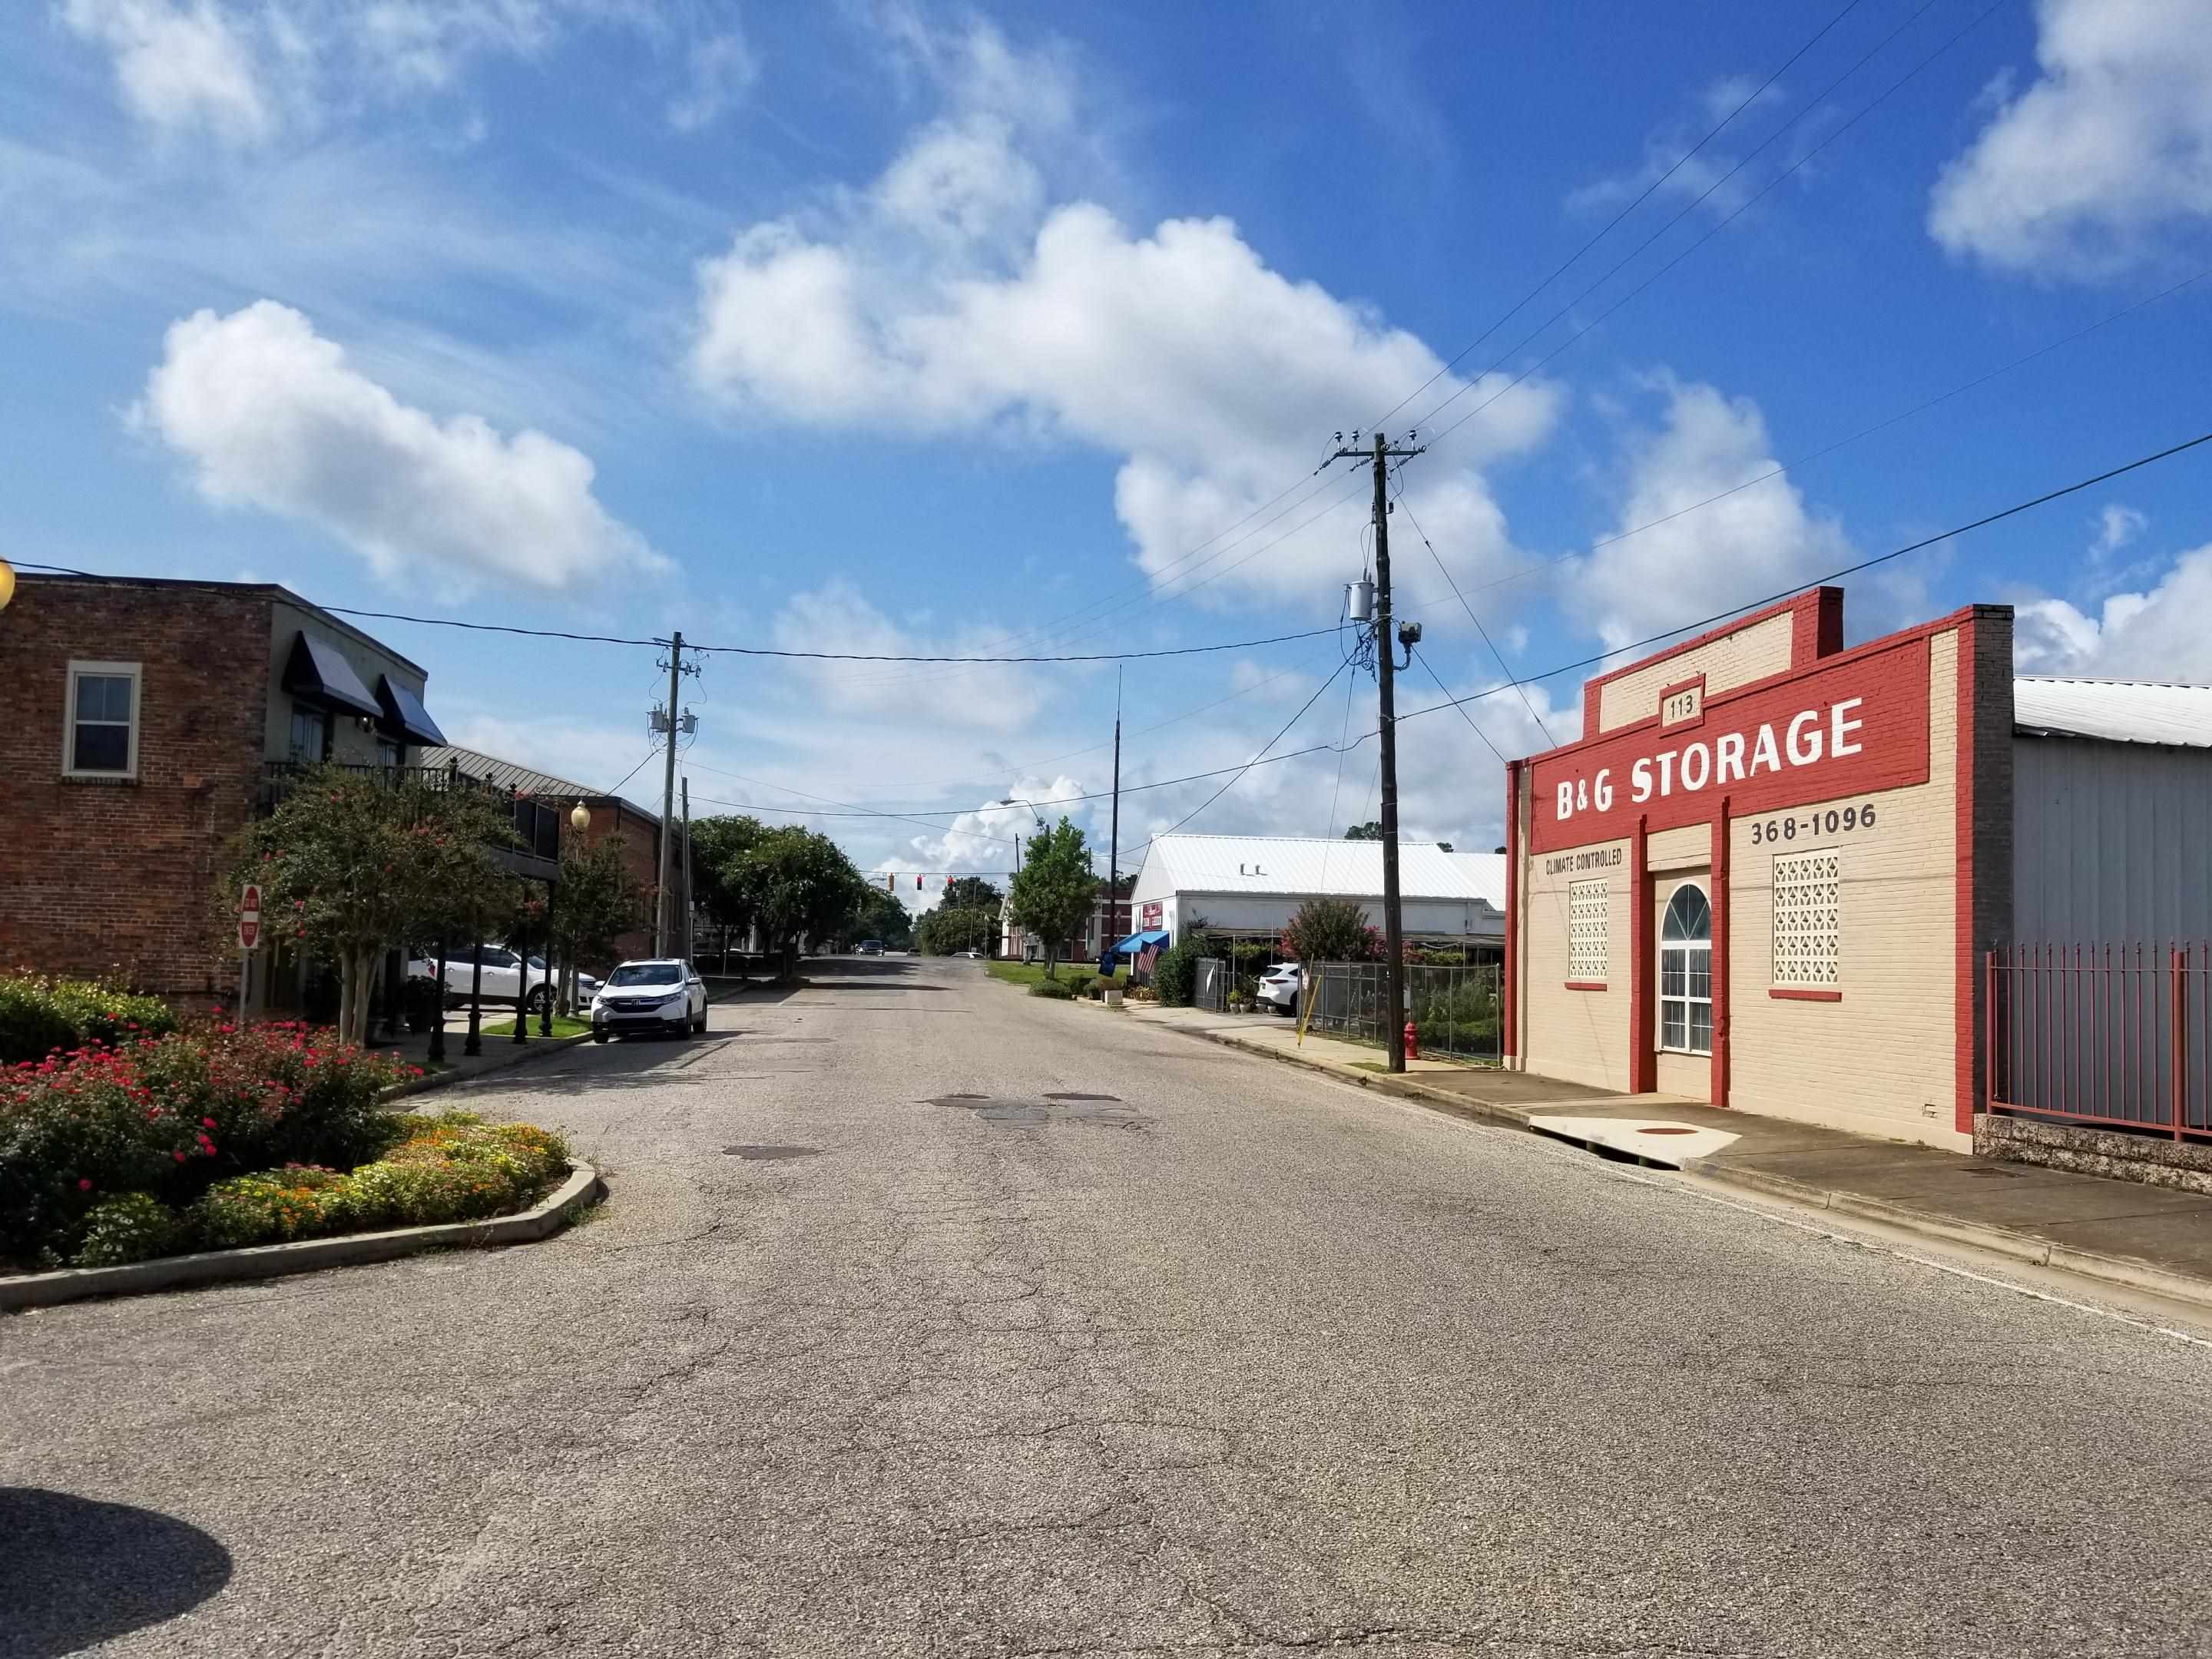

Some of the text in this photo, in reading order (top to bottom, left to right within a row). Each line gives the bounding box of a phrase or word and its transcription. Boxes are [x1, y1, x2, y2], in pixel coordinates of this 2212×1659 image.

[1671, 694, 1693, 718] 113
[1557, 697, 1863, 820] B&G STORAGE
[1751, 803, 1876, 845] 368-1096
[1546, 848, 1622, 876] CLIMATE CONTROLLED
